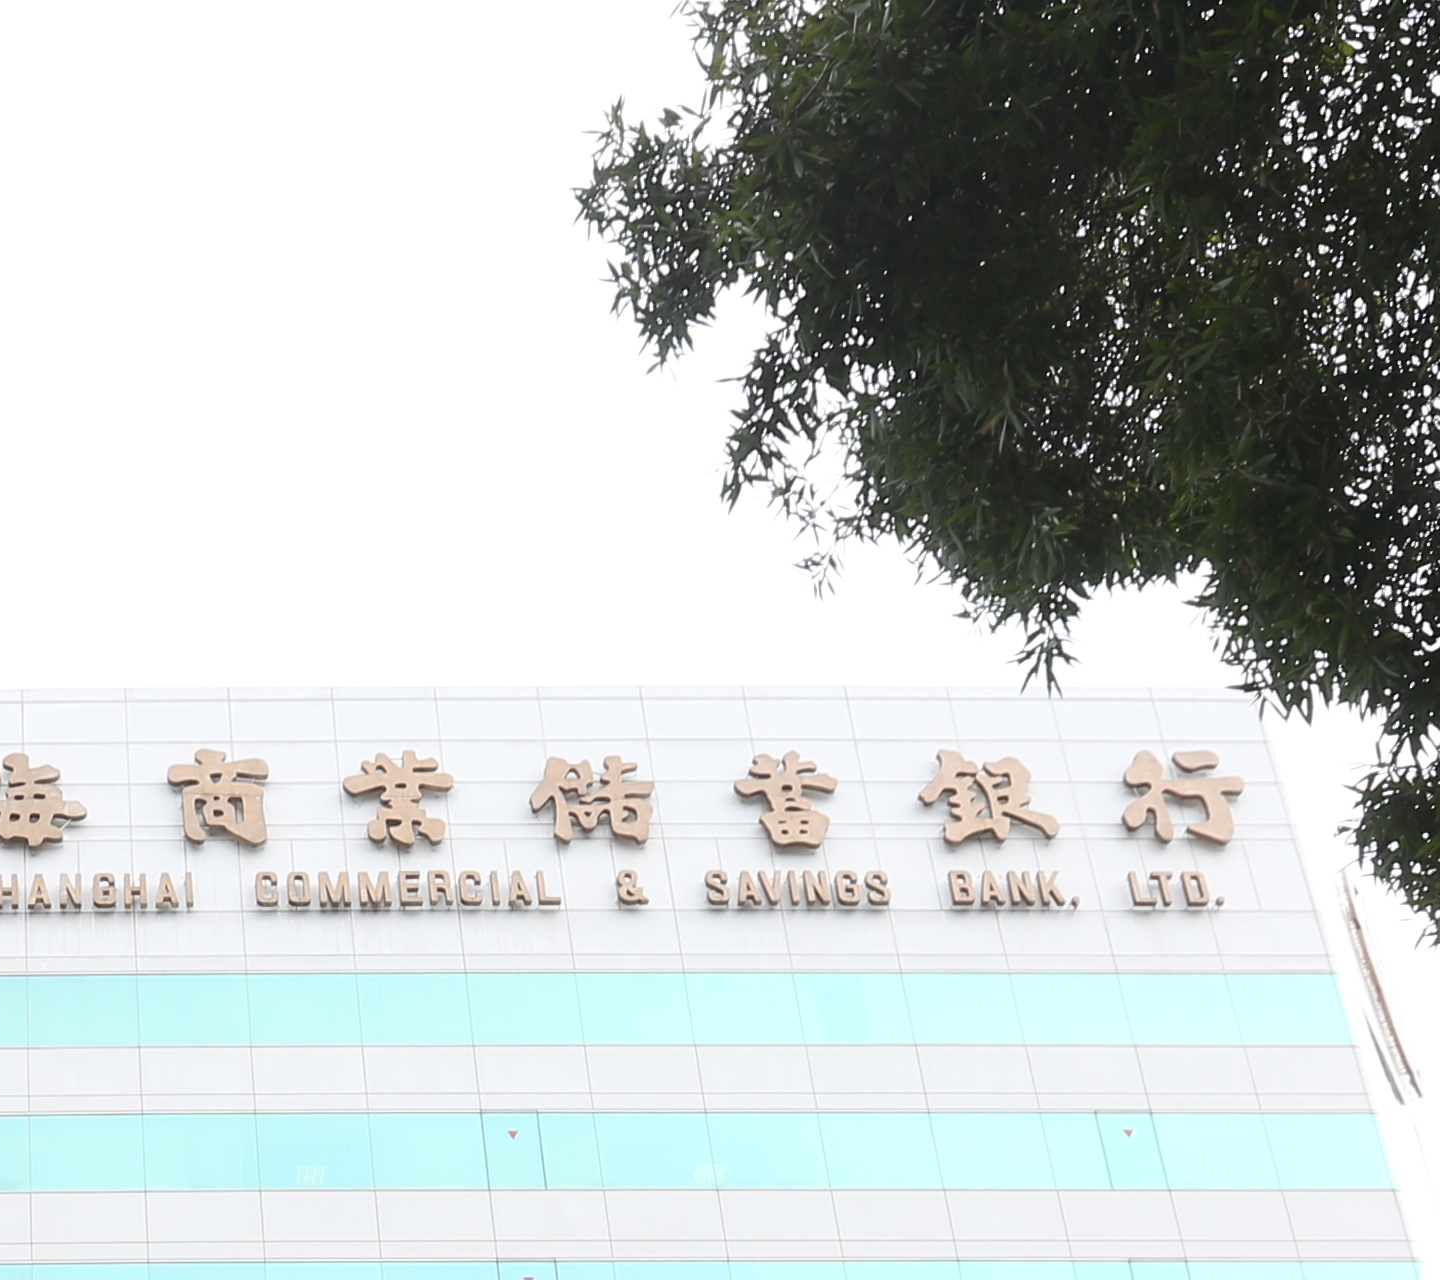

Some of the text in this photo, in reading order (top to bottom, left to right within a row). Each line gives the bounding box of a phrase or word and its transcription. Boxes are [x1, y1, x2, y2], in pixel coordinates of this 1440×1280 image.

[254, 870, 562, 908] COMMERCIAL
[617, 870, 650, 907] &
[703, 870, 892, 908] SAVINGS
[1127, 871, 1224, 910] LTD.
